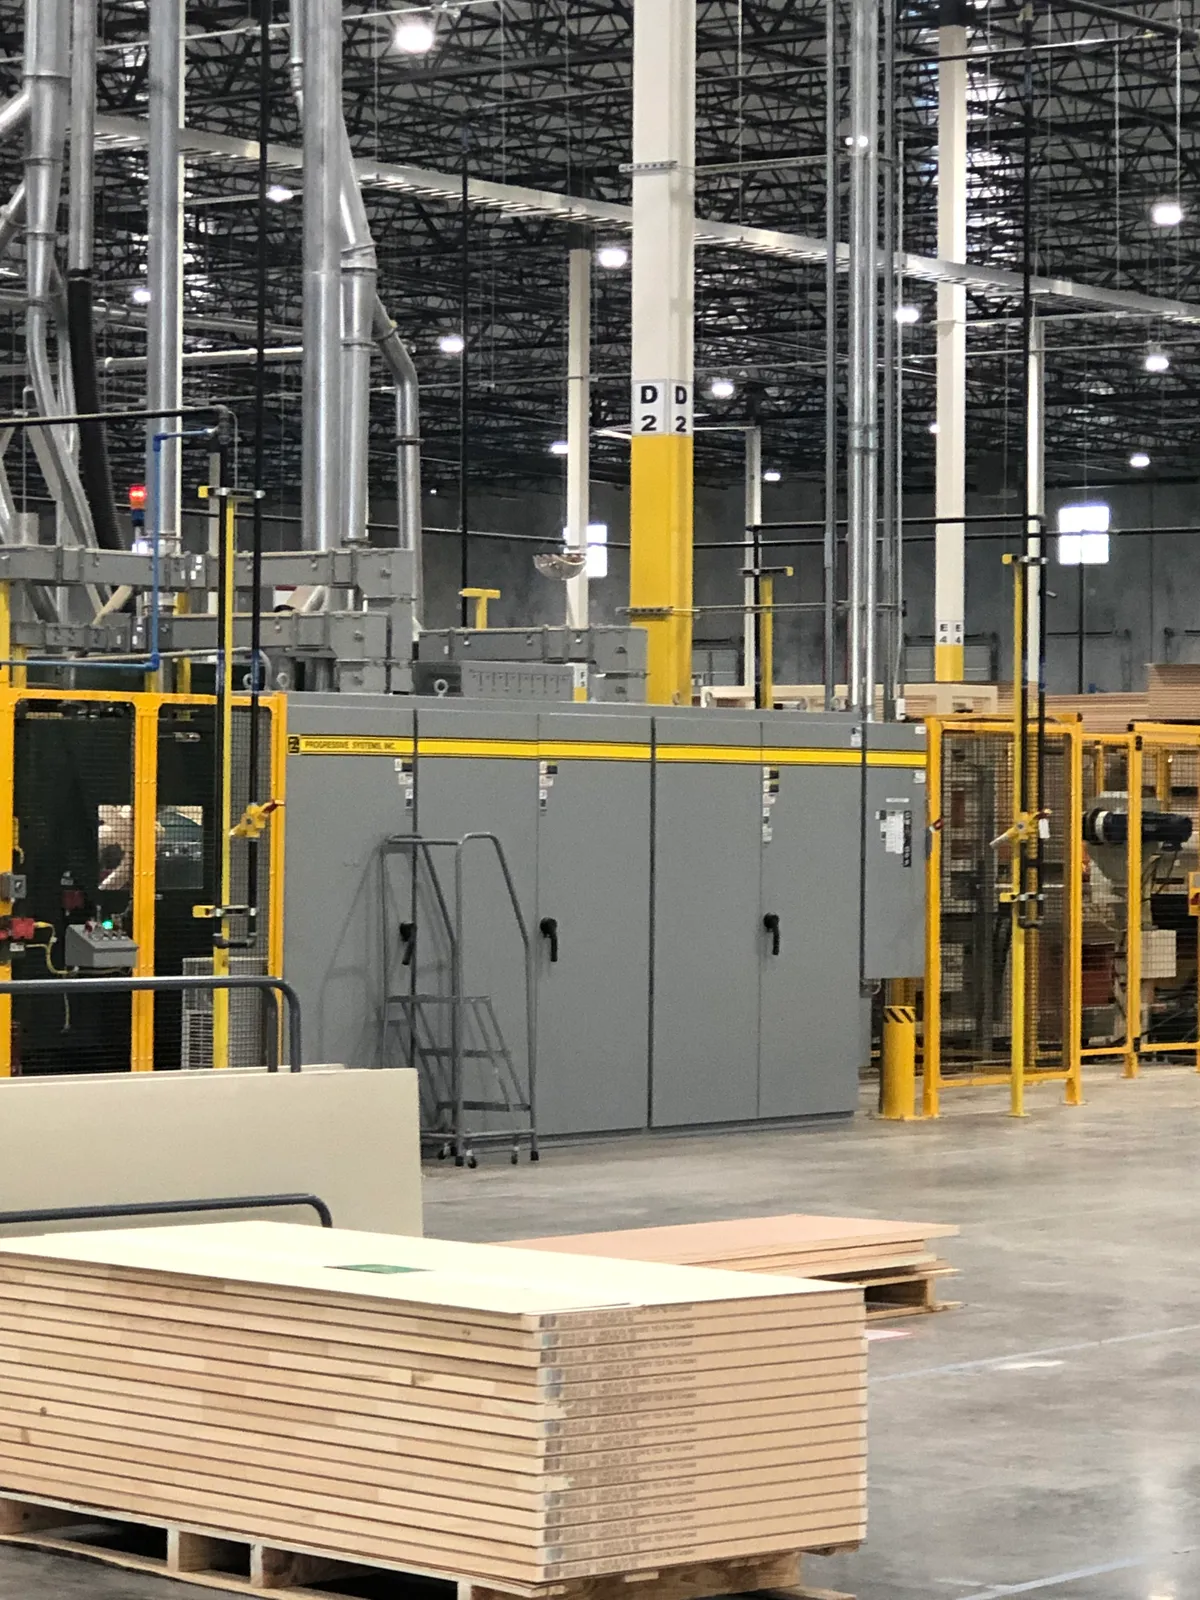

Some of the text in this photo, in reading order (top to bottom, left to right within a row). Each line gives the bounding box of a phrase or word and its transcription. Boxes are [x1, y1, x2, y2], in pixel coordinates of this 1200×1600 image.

[640, 385, 658, 404] D
[675, 385, 688, 405] D
[641, 414, 657, 432] 2
[675, 415, 687, 433] 2
[940, 624, 948, 632] E
[955, 624, 961, 632] E
[939, 635, 948, 643] 4
[304, 740, 349, 749] PROGRESSIVE
